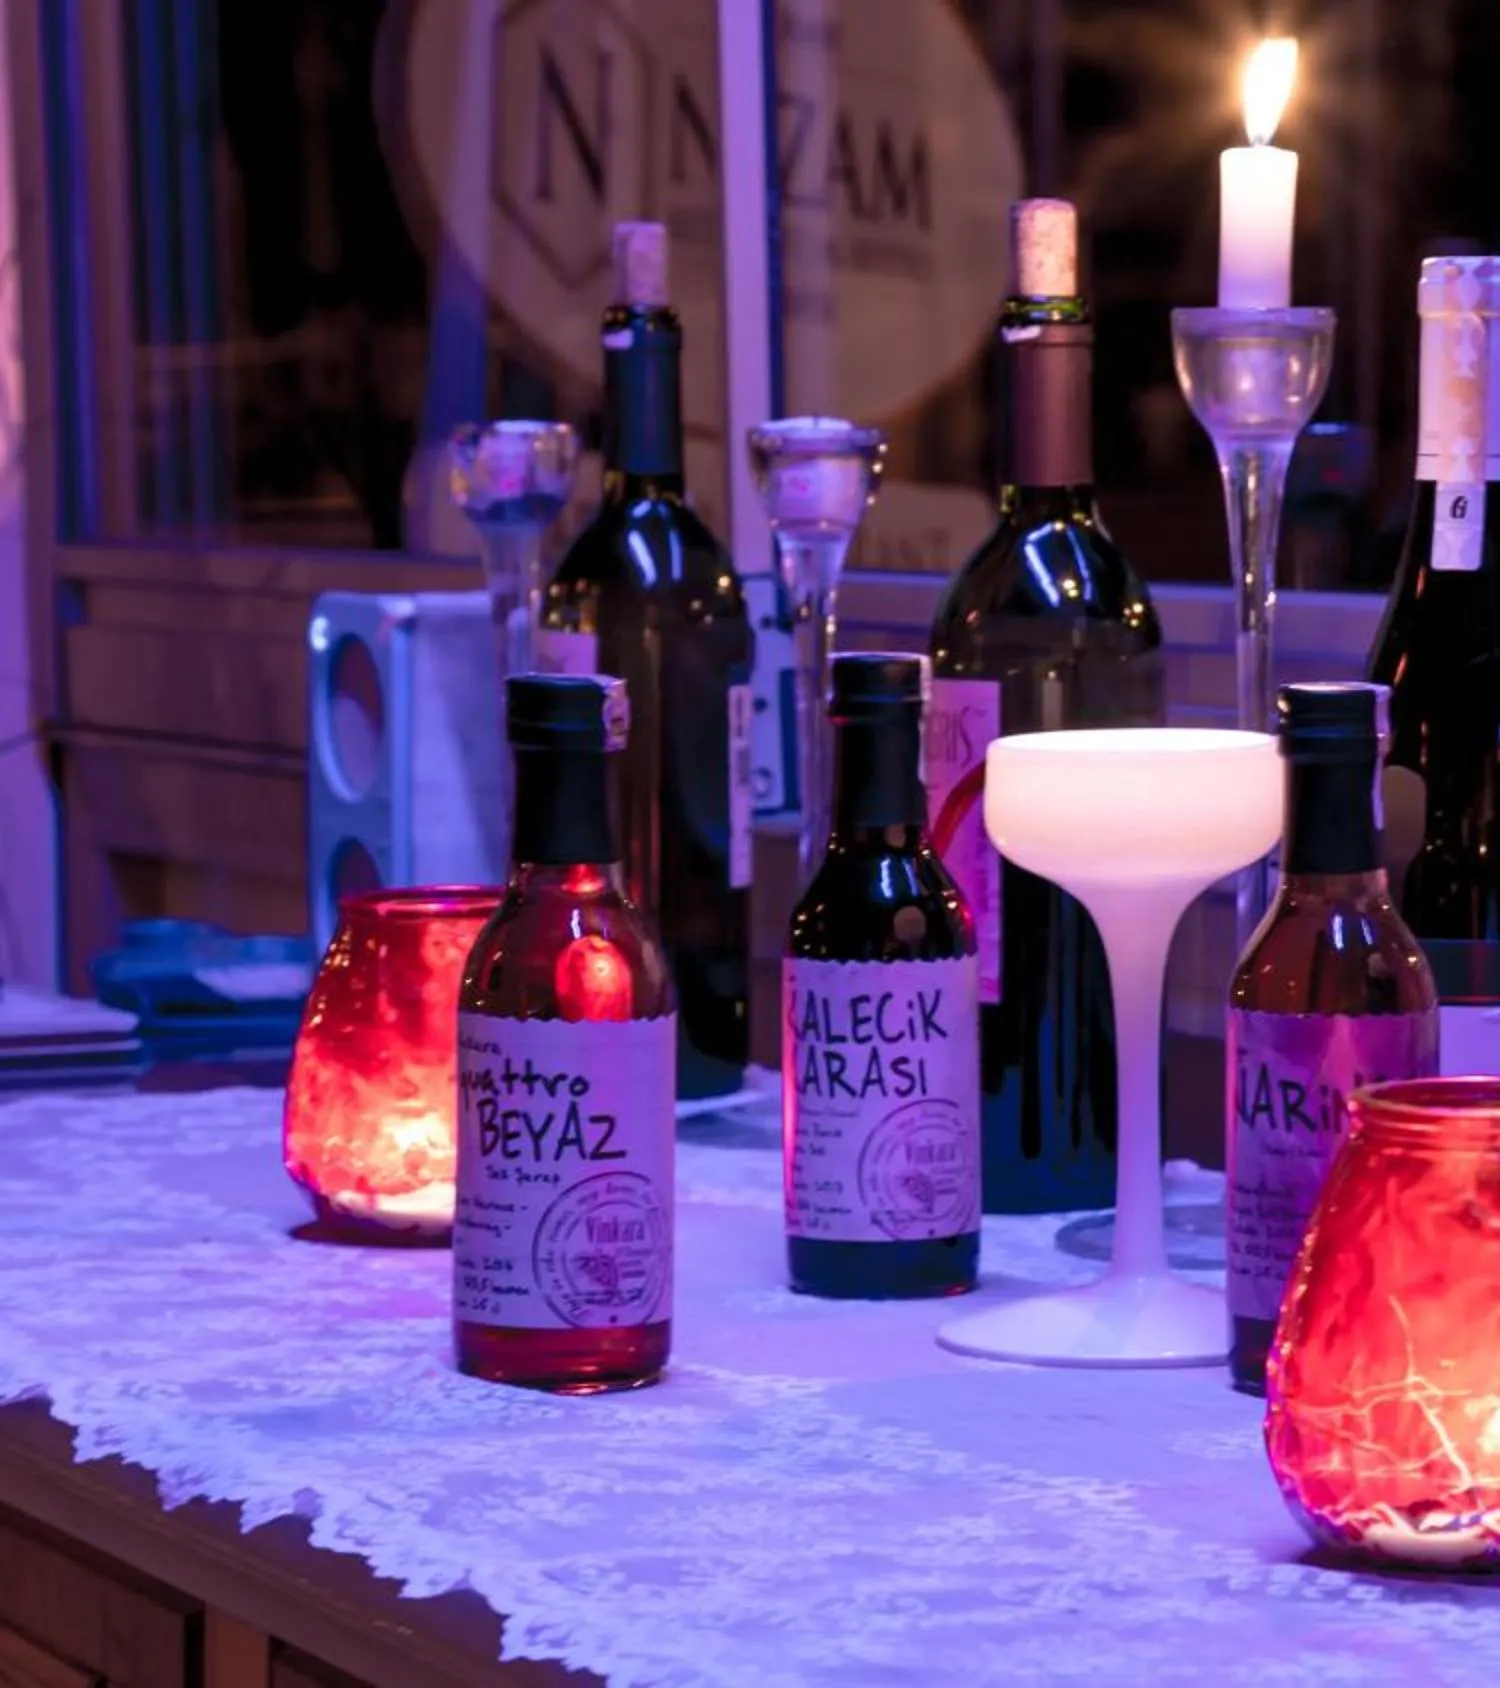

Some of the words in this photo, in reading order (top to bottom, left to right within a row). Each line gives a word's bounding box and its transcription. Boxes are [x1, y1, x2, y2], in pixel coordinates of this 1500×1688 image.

[537, 45, 611, 202] N
[668, 73, 934, 231] NZAM
[477, 1097, 628, 1163] BEYAZ
